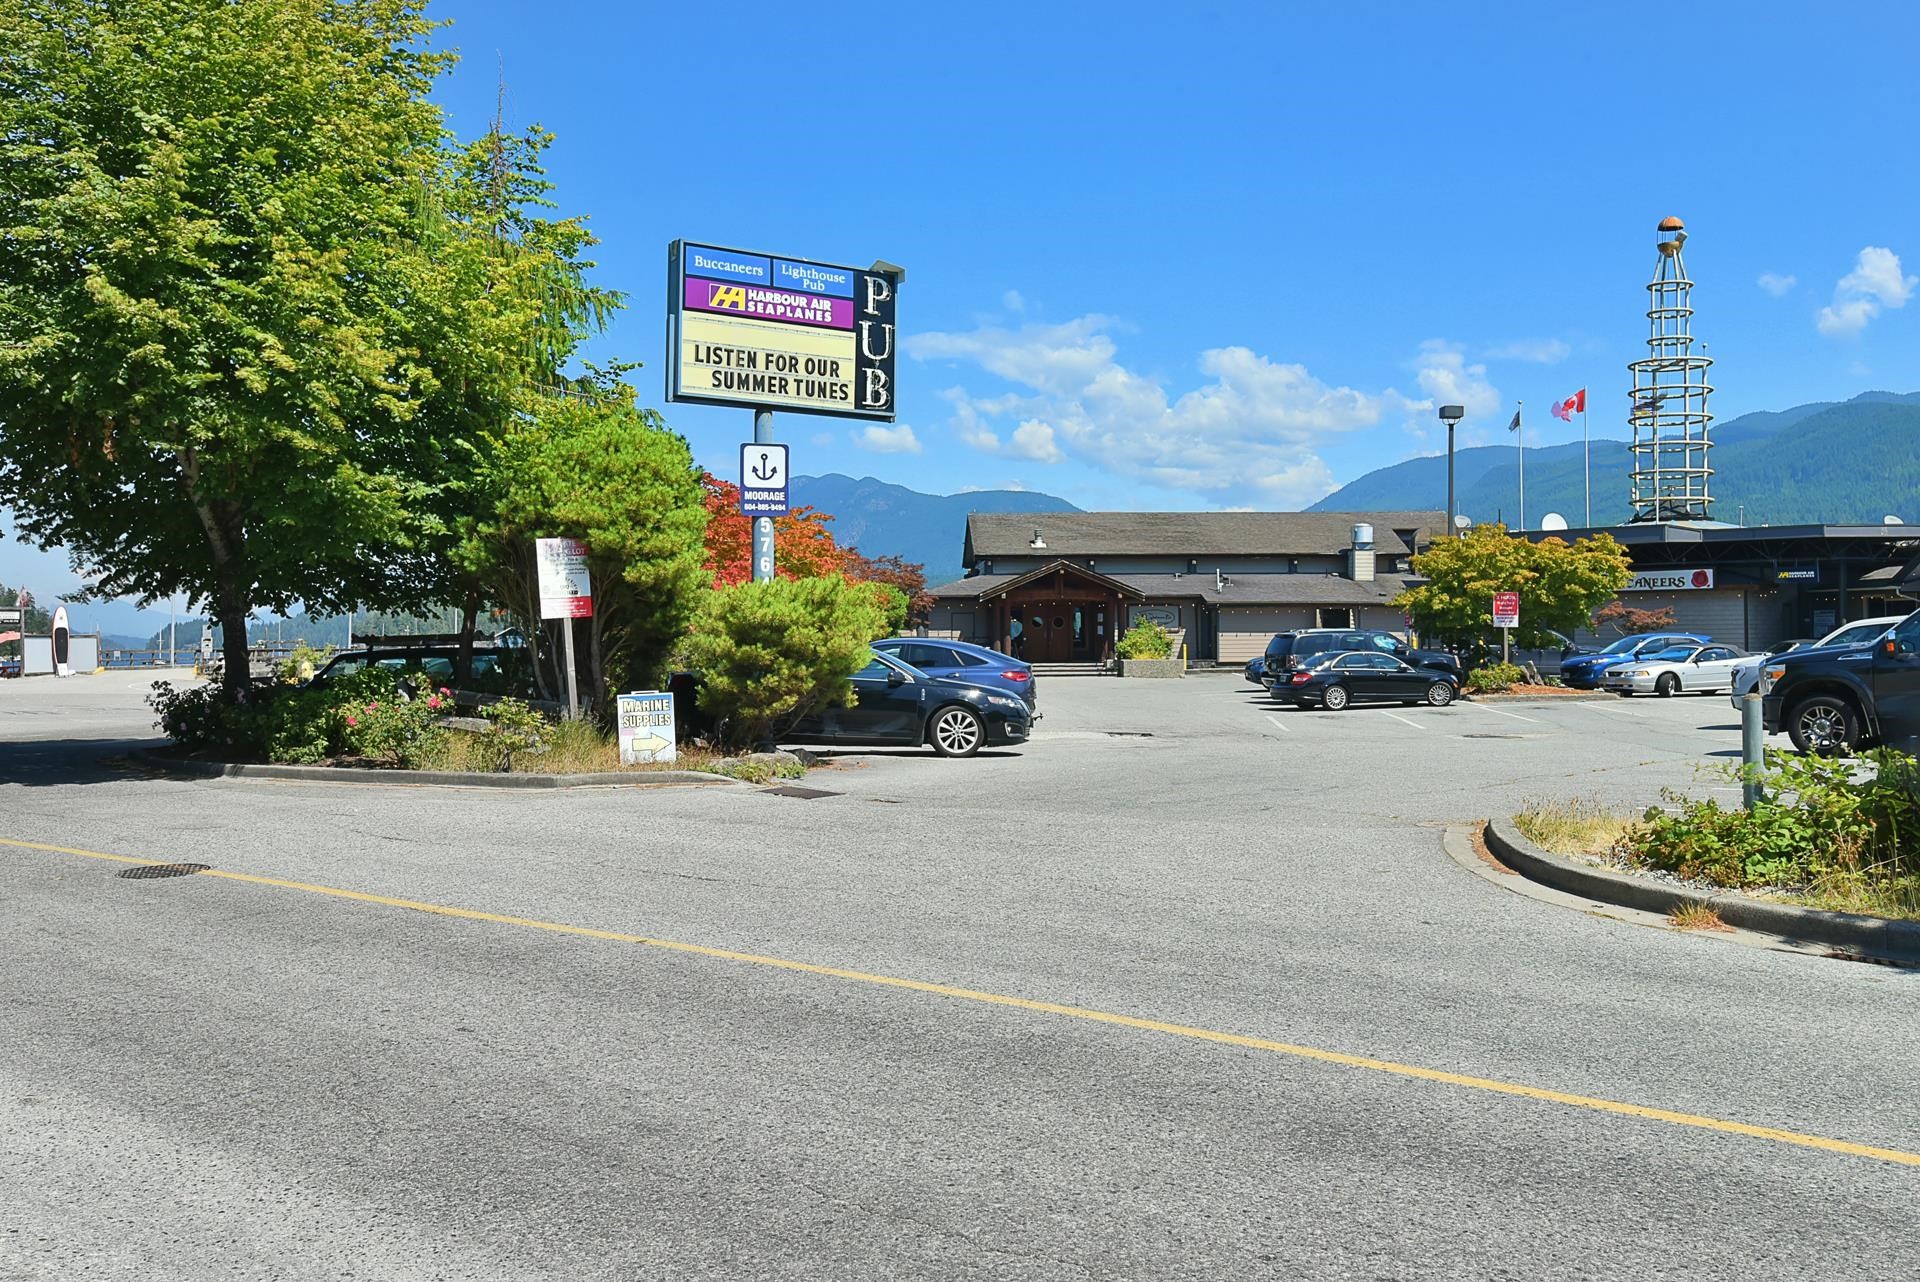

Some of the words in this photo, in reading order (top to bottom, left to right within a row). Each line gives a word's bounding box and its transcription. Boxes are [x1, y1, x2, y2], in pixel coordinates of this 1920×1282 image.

[694, 256, 764, 277] Buccaneers
[781, 264, 846, 284] Lighthouse
[803, 278, 825, 292] Pub
[748, 289, 808, 307] HARBOUR
[811, 298, 832, 311] AIR
[747, 300, 832, 323] SEAPLANES
[859, 275, 894, 409] PUB
[694, 344, 757, 369] LISTEN
[764, 353, 800, 374] FOR
[804, 358, 840, 378] OUR
[711, 370, 789, 395] SUMMER
[793, 381, 849, 401] TUNES
[744, 491, 786, 501] MOORAGE
[1626, 576, 1686, 590] CANEERS
[622, 699, 671, 713] MARINE
[622, 713, 672, 728] SUPPLIES
